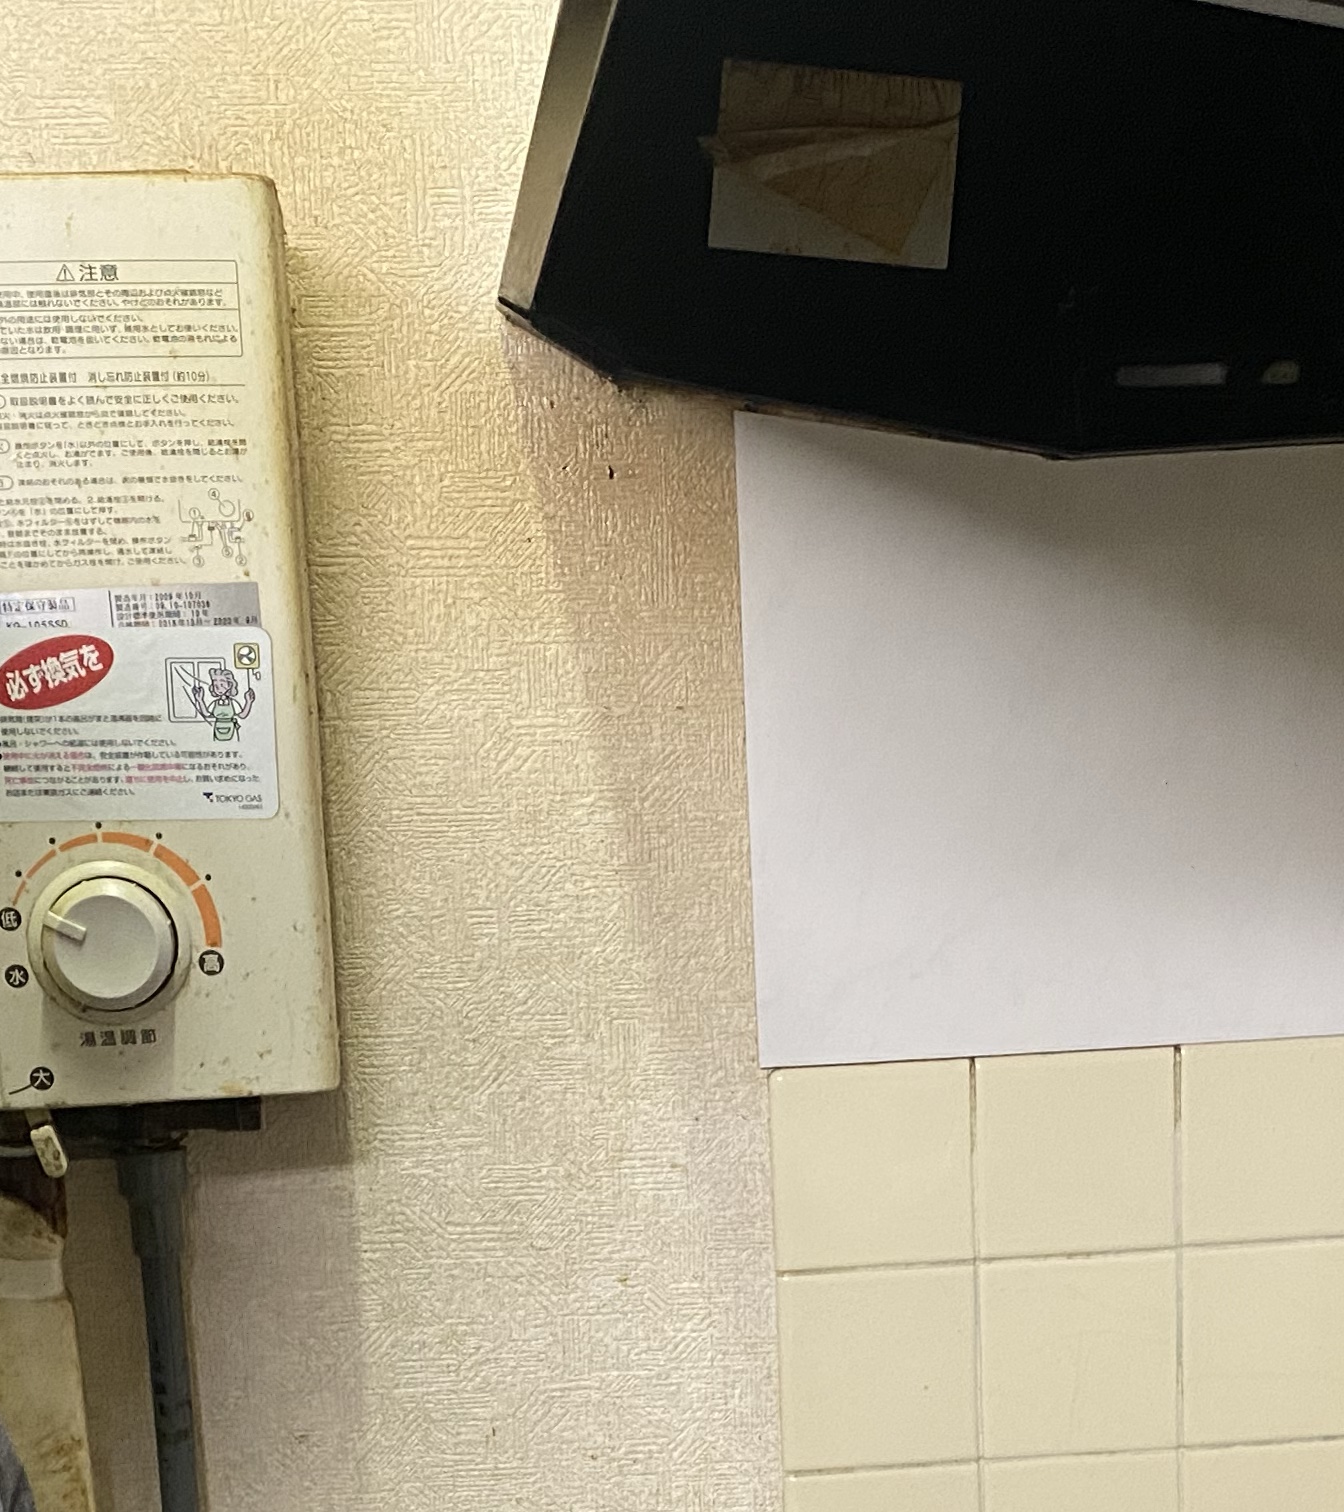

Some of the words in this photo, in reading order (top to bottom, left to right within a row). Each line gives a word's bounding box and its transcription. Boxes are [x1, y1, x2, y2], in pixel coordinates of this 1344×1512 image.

[78, 263, 120, 282] 注意
[6, 644, 104, 702] 必ず換気を
[214, 794, 244, 803] TOKYO
[245, 793, 263, 803] GAS
